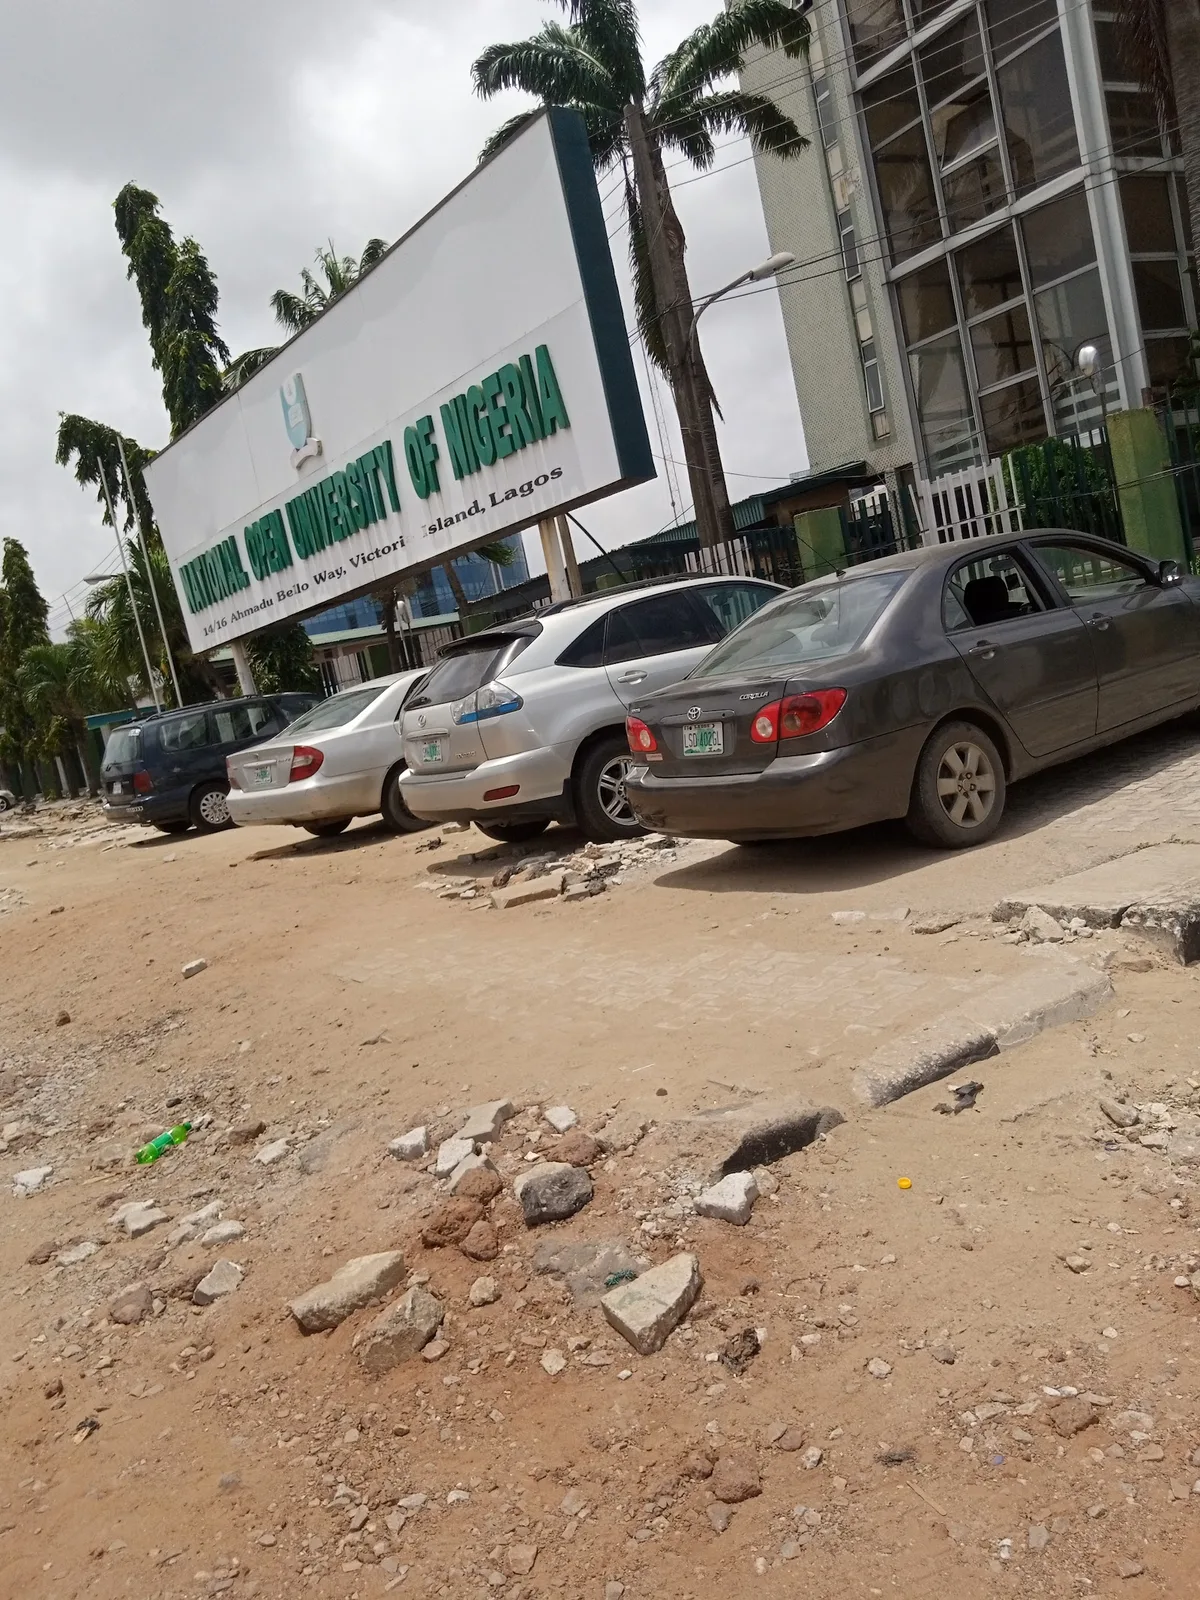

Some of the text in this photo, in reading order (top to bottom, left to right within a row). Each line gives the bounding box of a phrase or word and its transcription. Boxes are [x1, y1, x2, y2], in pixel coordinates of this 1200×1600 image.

[179, 344, 570, 614] NATIONAL OPEN UNIVERSITY OF NIGERIA
[203, 617, 228, 636] 14/16
[230, 598, 274, 623] Ahmadu
[276, 582, 310, 602] Bello
[313, 566, 347, 585] Way,
[349, 535, 415, 569] Victori
[489, 466, 564, 508] Lagos
